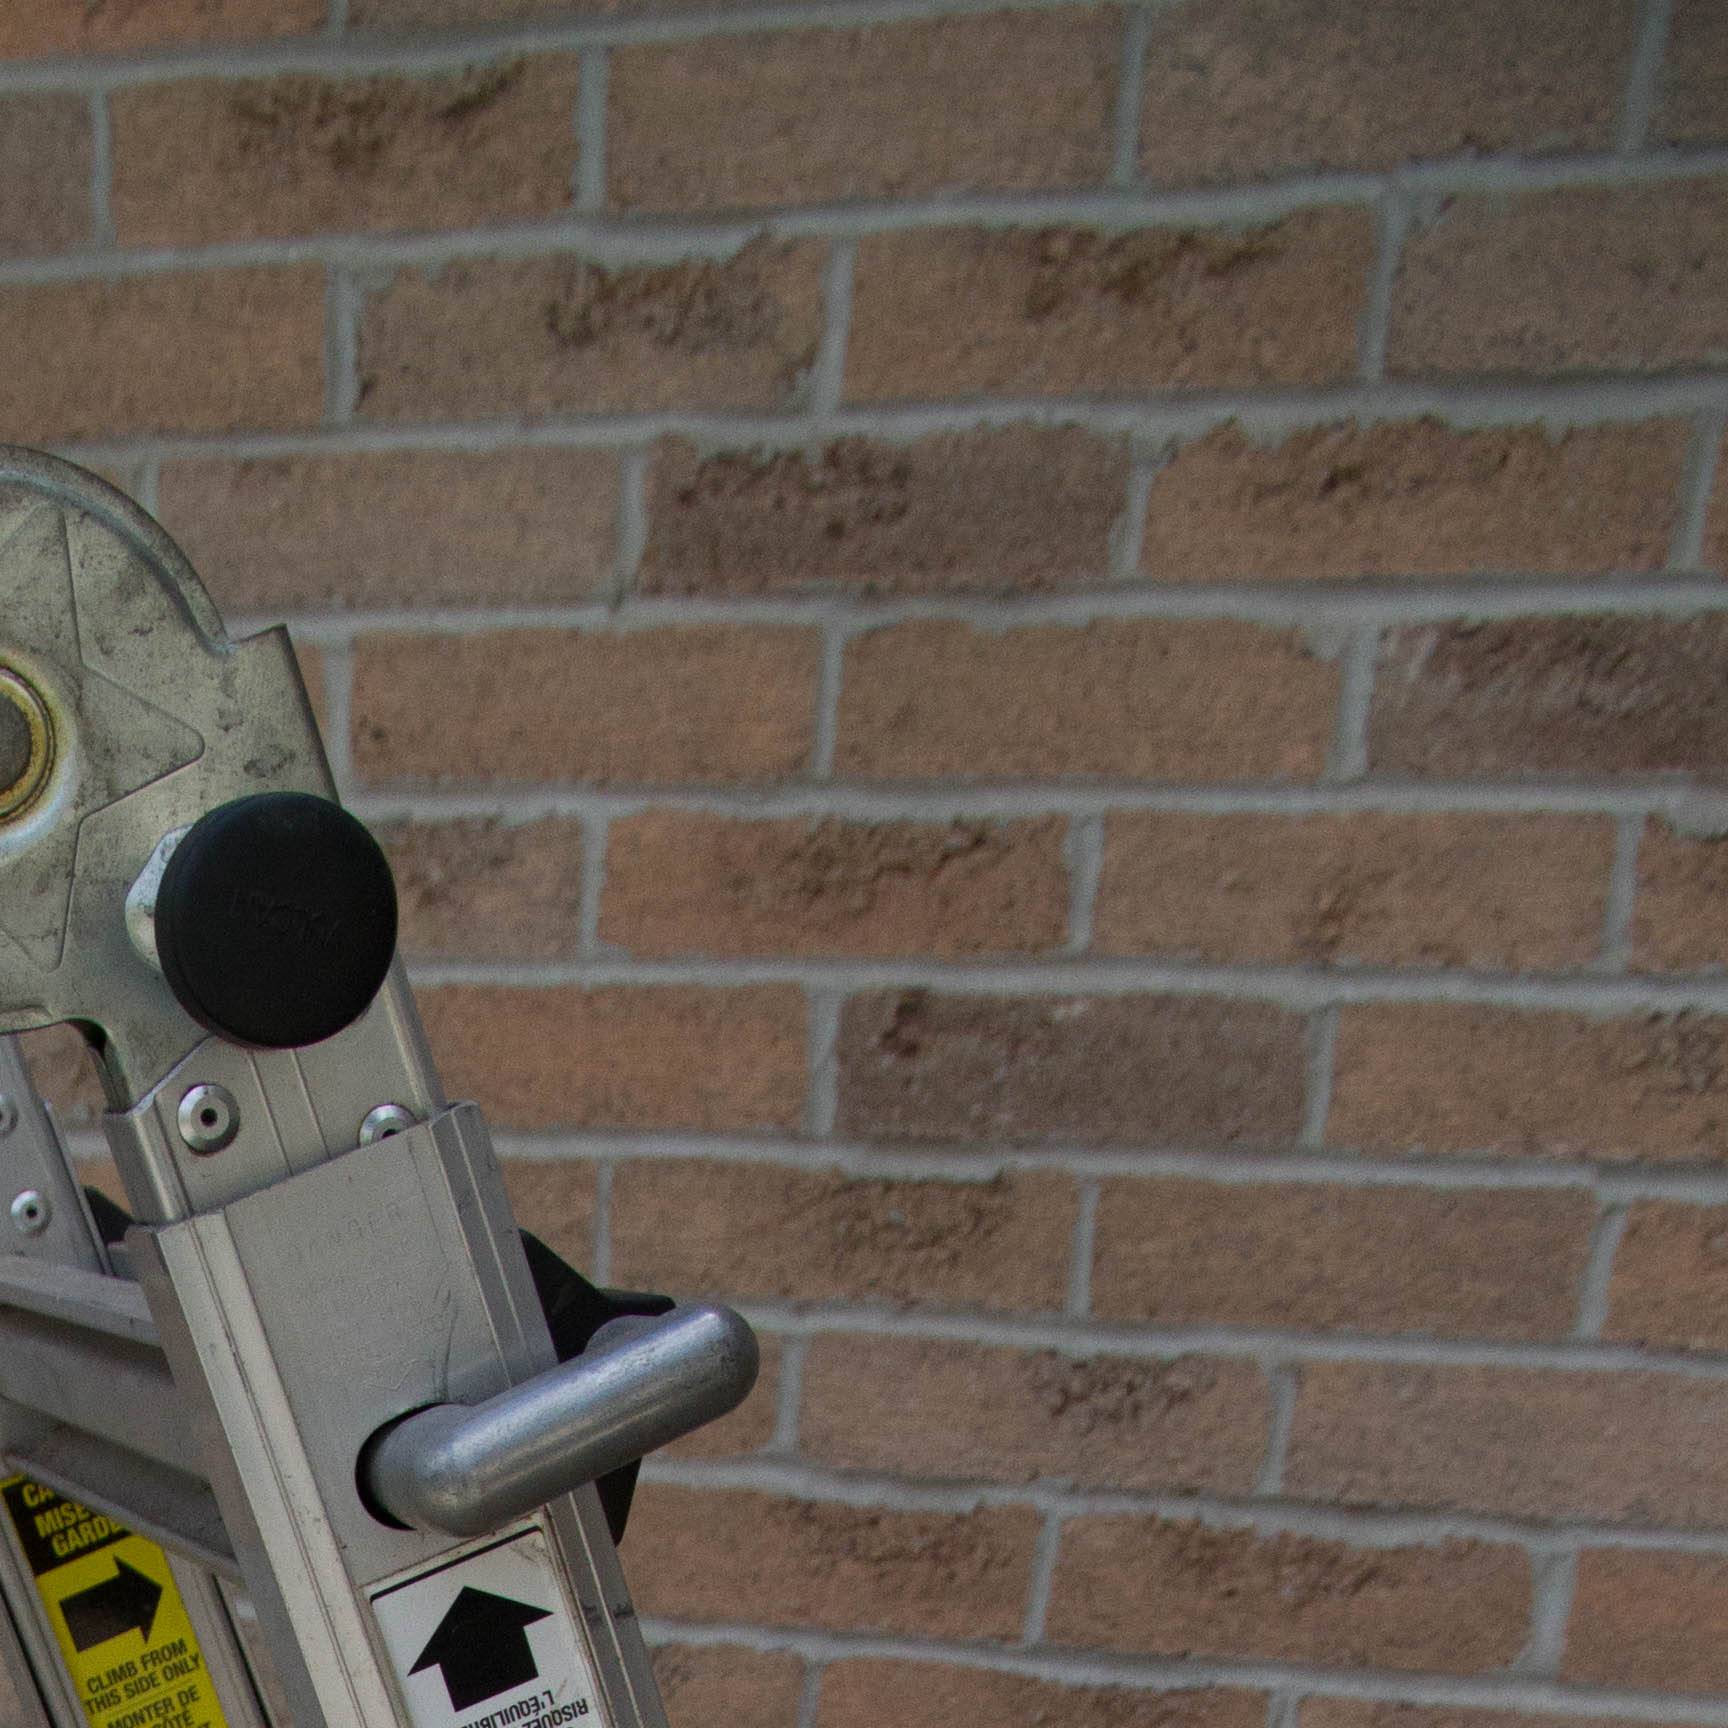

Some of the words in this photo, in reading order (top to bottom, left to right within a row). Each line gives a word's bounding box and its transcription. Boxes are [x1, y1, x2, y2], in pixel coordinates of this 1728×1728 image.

[82, 1688, 121, 1715] THIS
[122, 1670, 161, 1699] SIDE
[161, 1651, 200, 1682] ONLY
[85, 1660, 138, 1694] CLIMB
[139, 1637, 188, 1671] FROM
[175, 1684, 200, 1709] DE
